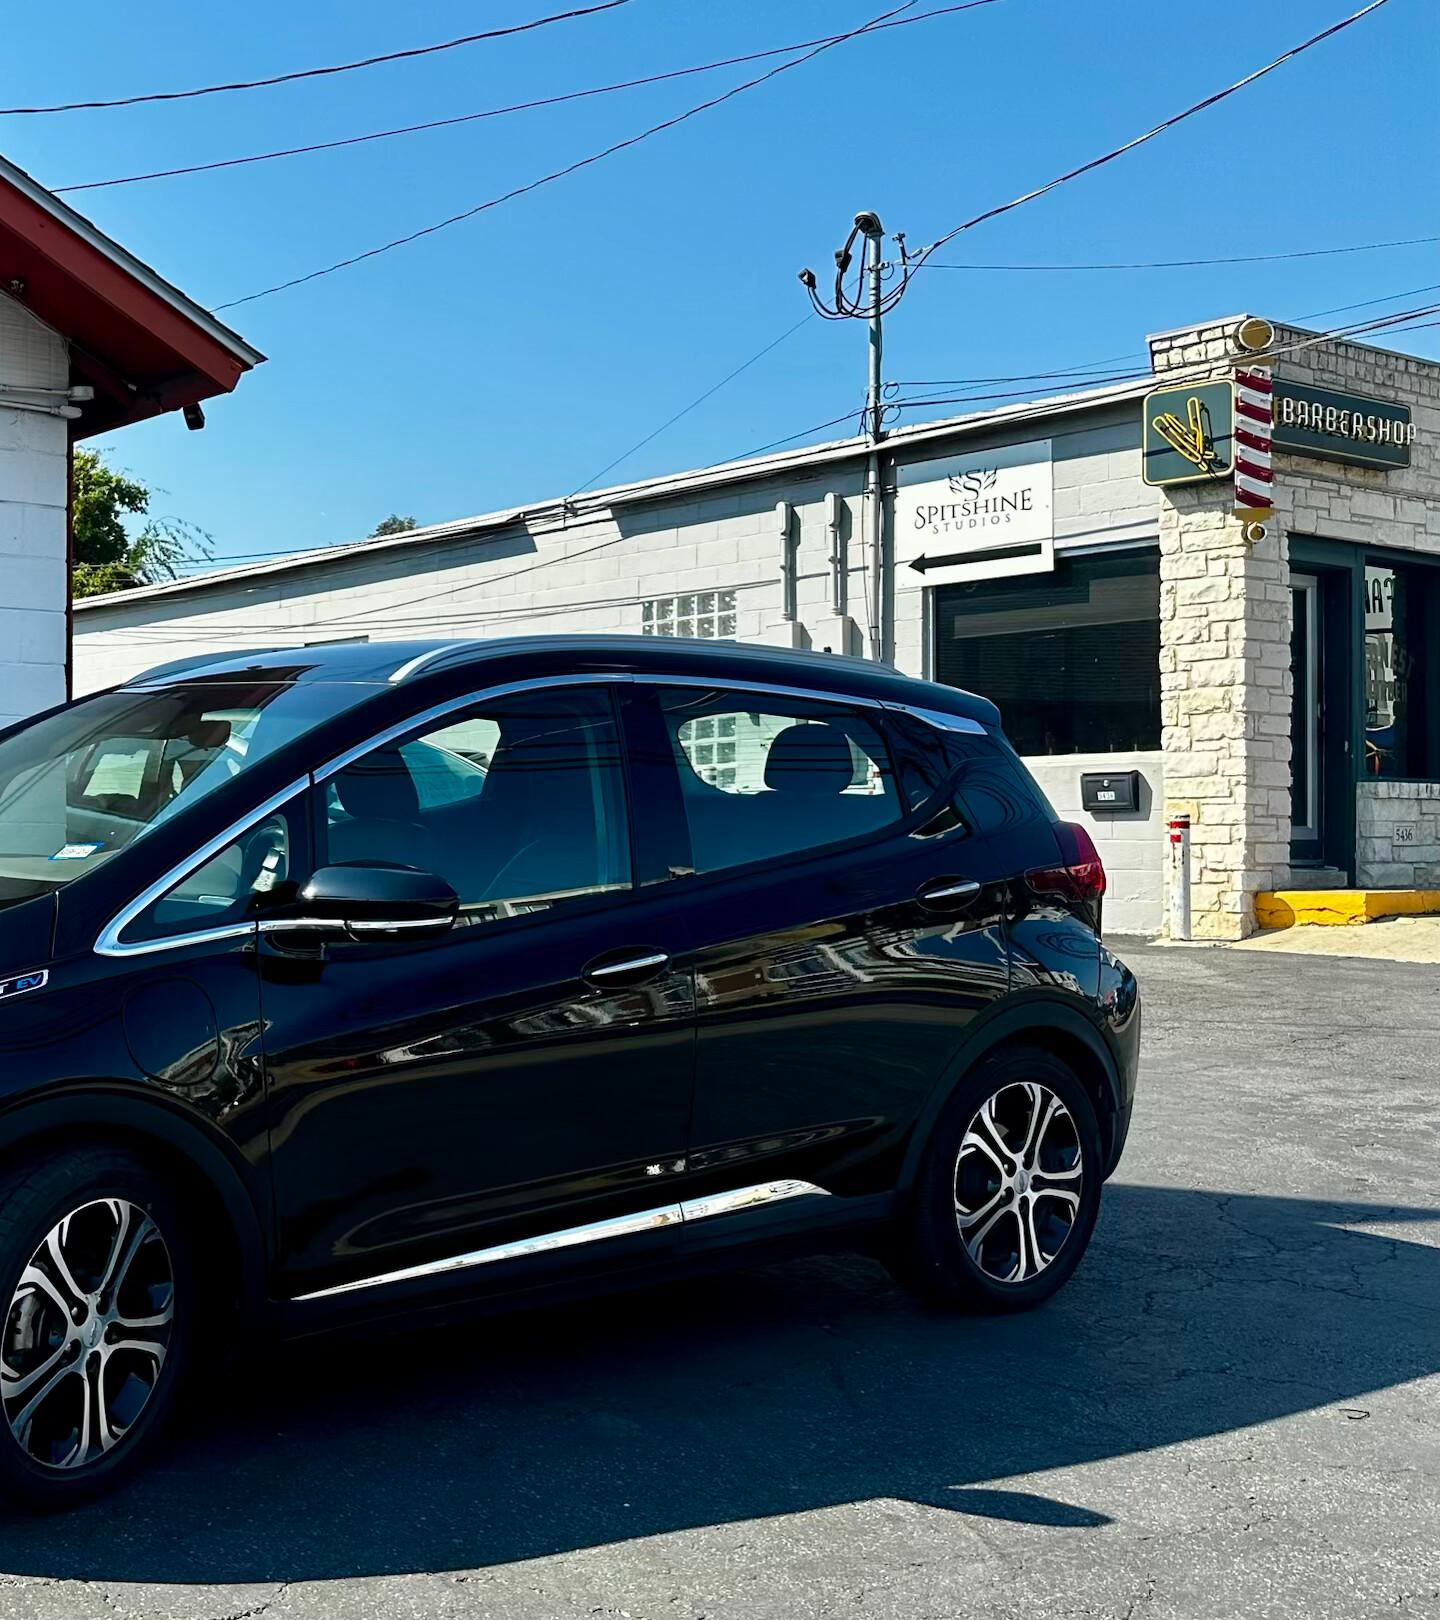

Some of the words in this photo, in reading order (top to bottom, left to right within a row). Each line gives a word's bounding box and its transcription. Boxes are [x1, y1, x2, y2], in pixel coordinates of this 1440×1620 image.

[1283, 397, 1417, 446] BARBERSHOP
[914, 488, 1033, 530] SPITSHINE
[933, 513, 1011, 535] STUDIOS
[1395, 828, 1413, 841] 5436
[16, 975, 42, 990] EV
